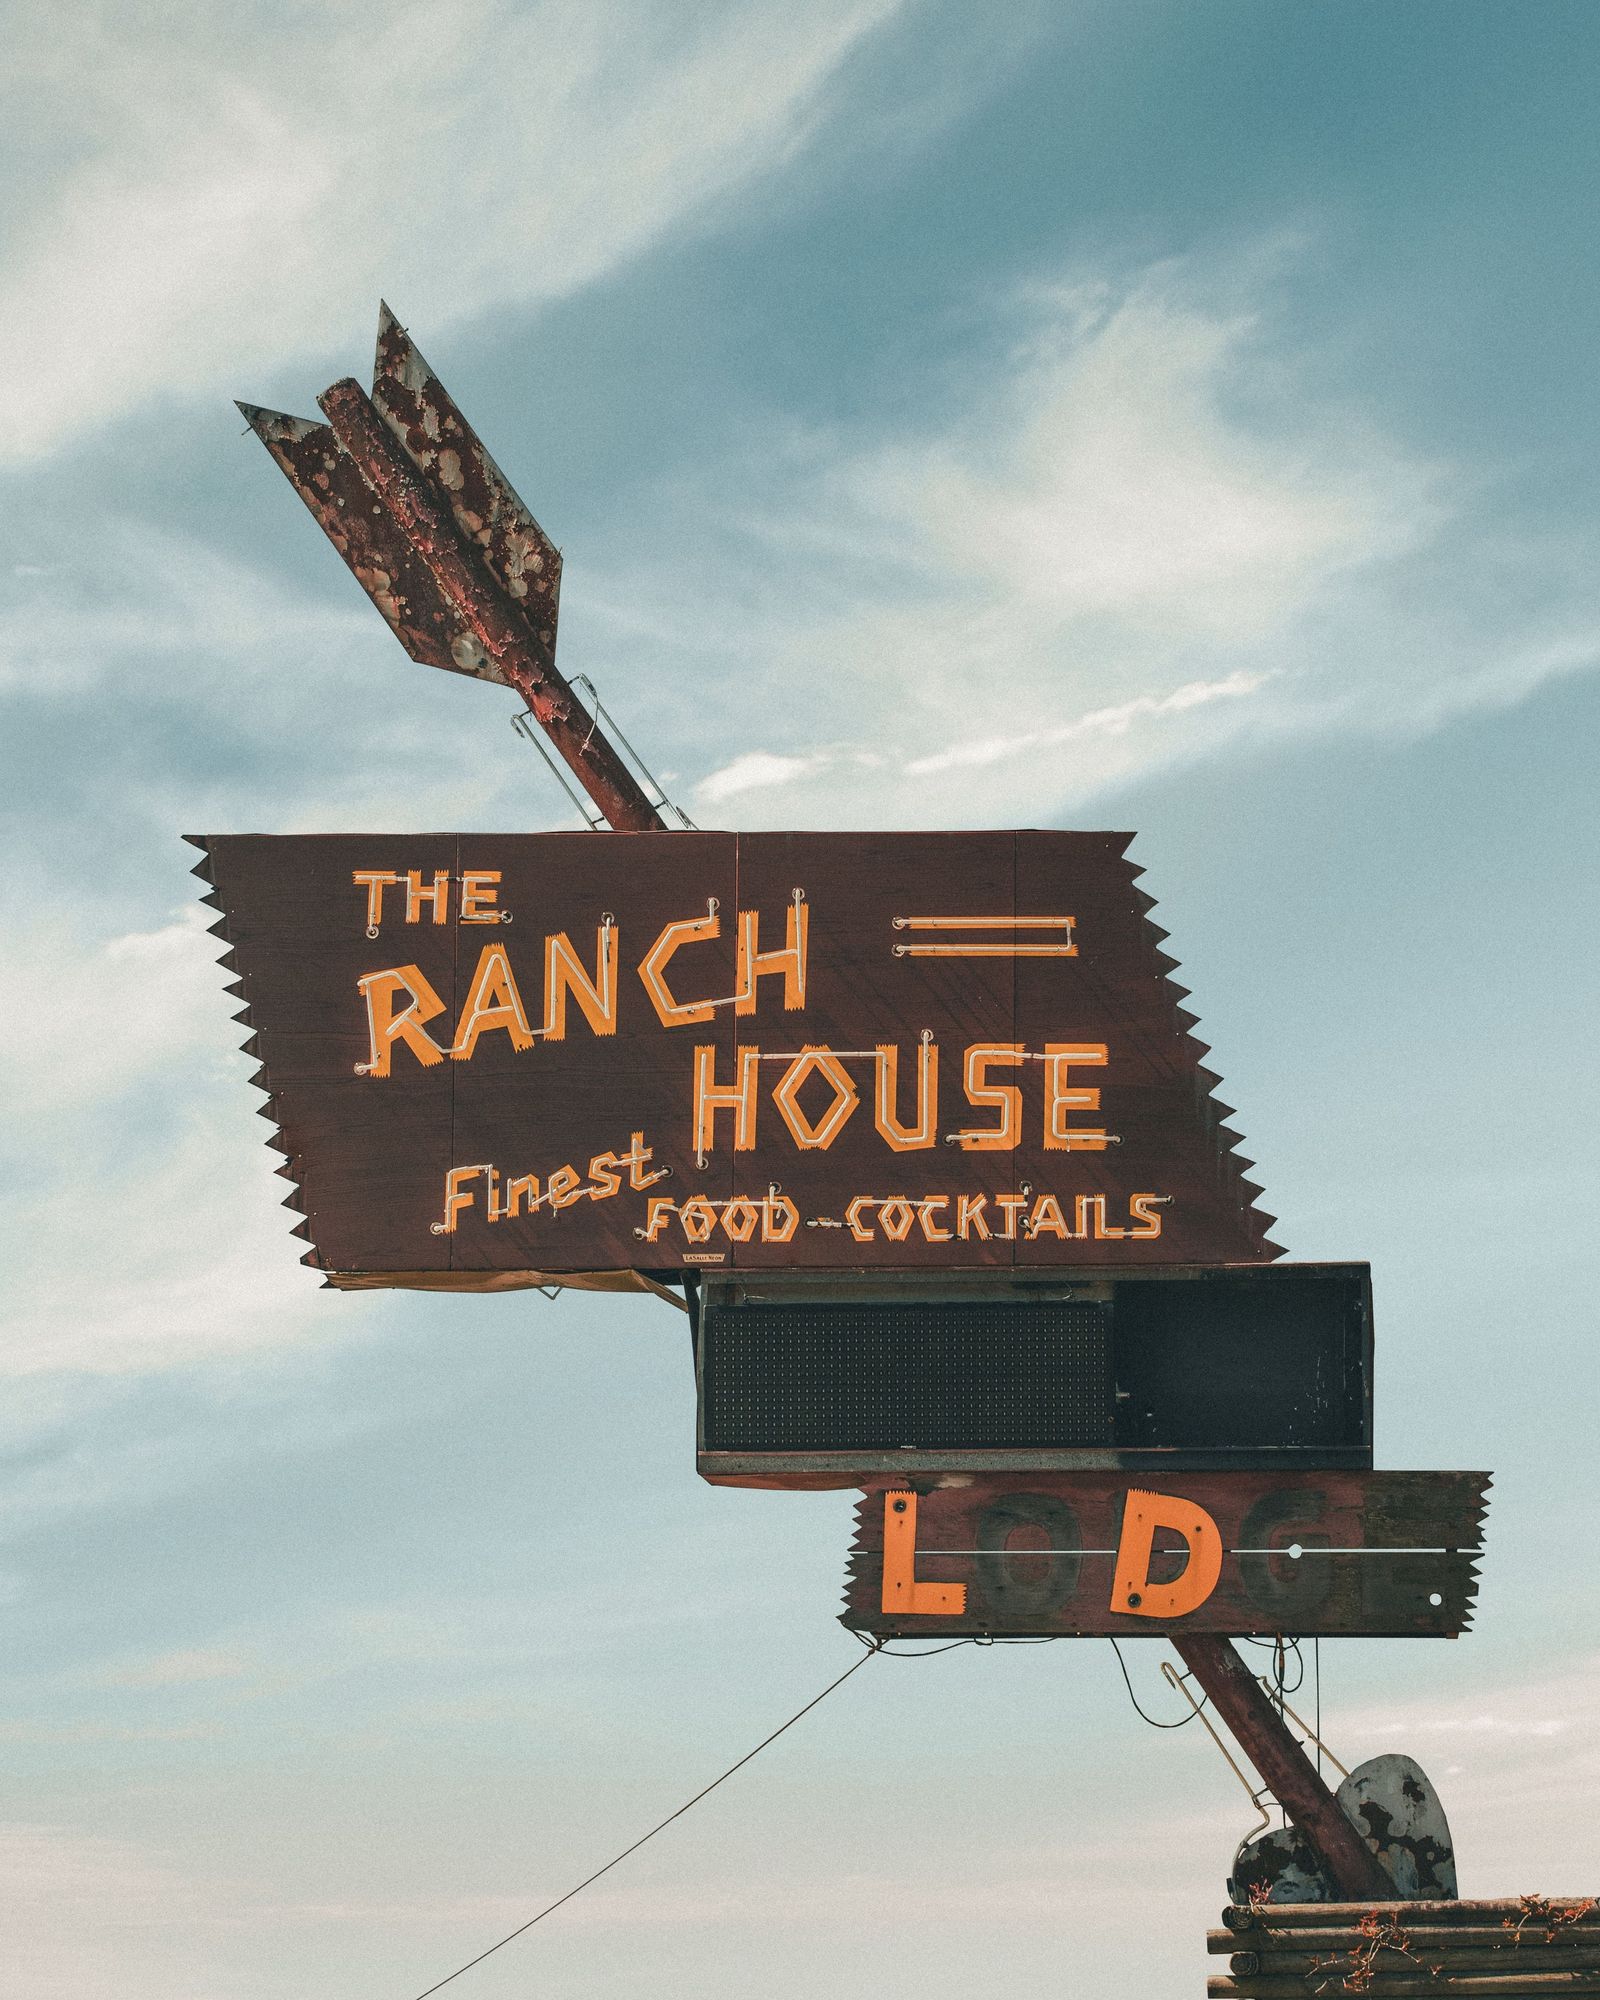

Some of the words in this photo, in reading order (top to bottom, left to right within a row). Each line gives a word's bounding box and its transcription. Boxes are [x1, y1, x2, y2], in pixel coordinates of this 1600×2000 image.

[352, 870, 503, 925] THE
[358, 902, 810, 1077] RANCH
[693, 1042, 1109, 1152] HOUSE
[444, 1130, 661, 1233] Finest
[647, 1193, 800, 1244] FOOD
[844, 1192, 1163, 1243] COCKTAILS
